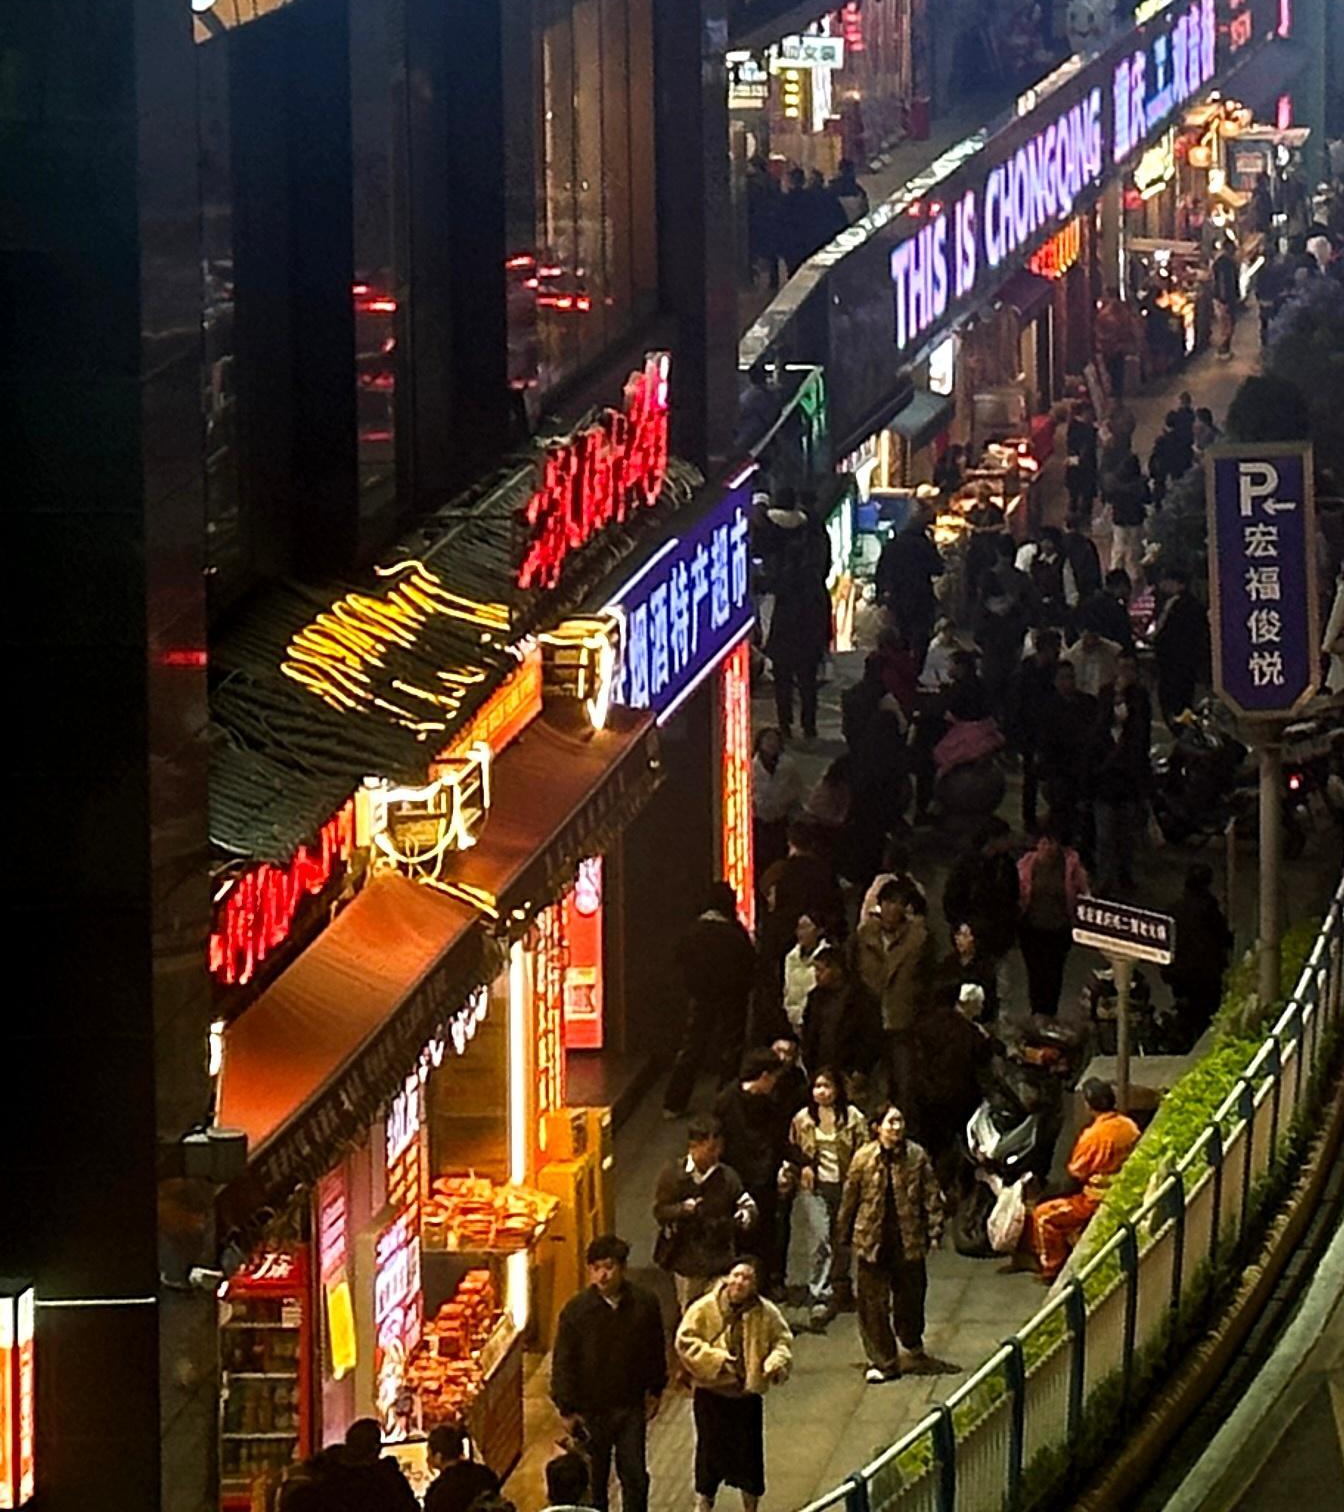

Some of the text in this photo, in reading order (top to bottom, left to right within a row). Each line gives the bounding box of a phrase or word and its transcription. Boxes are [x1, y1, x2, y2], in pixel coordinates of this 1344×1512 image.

[891, 220, 949, 352] THIS
[955, 191, 976, 300] IS
[983, 86, 1102, 271] CHONGQING
[1113, 48, 1147, 165] 重庆
[1237, 461, 1279, 517] P
[609, 506, 751, 710] 烟酒特产超市
[1242, 523, 1286, 688] 宏福俊悦
